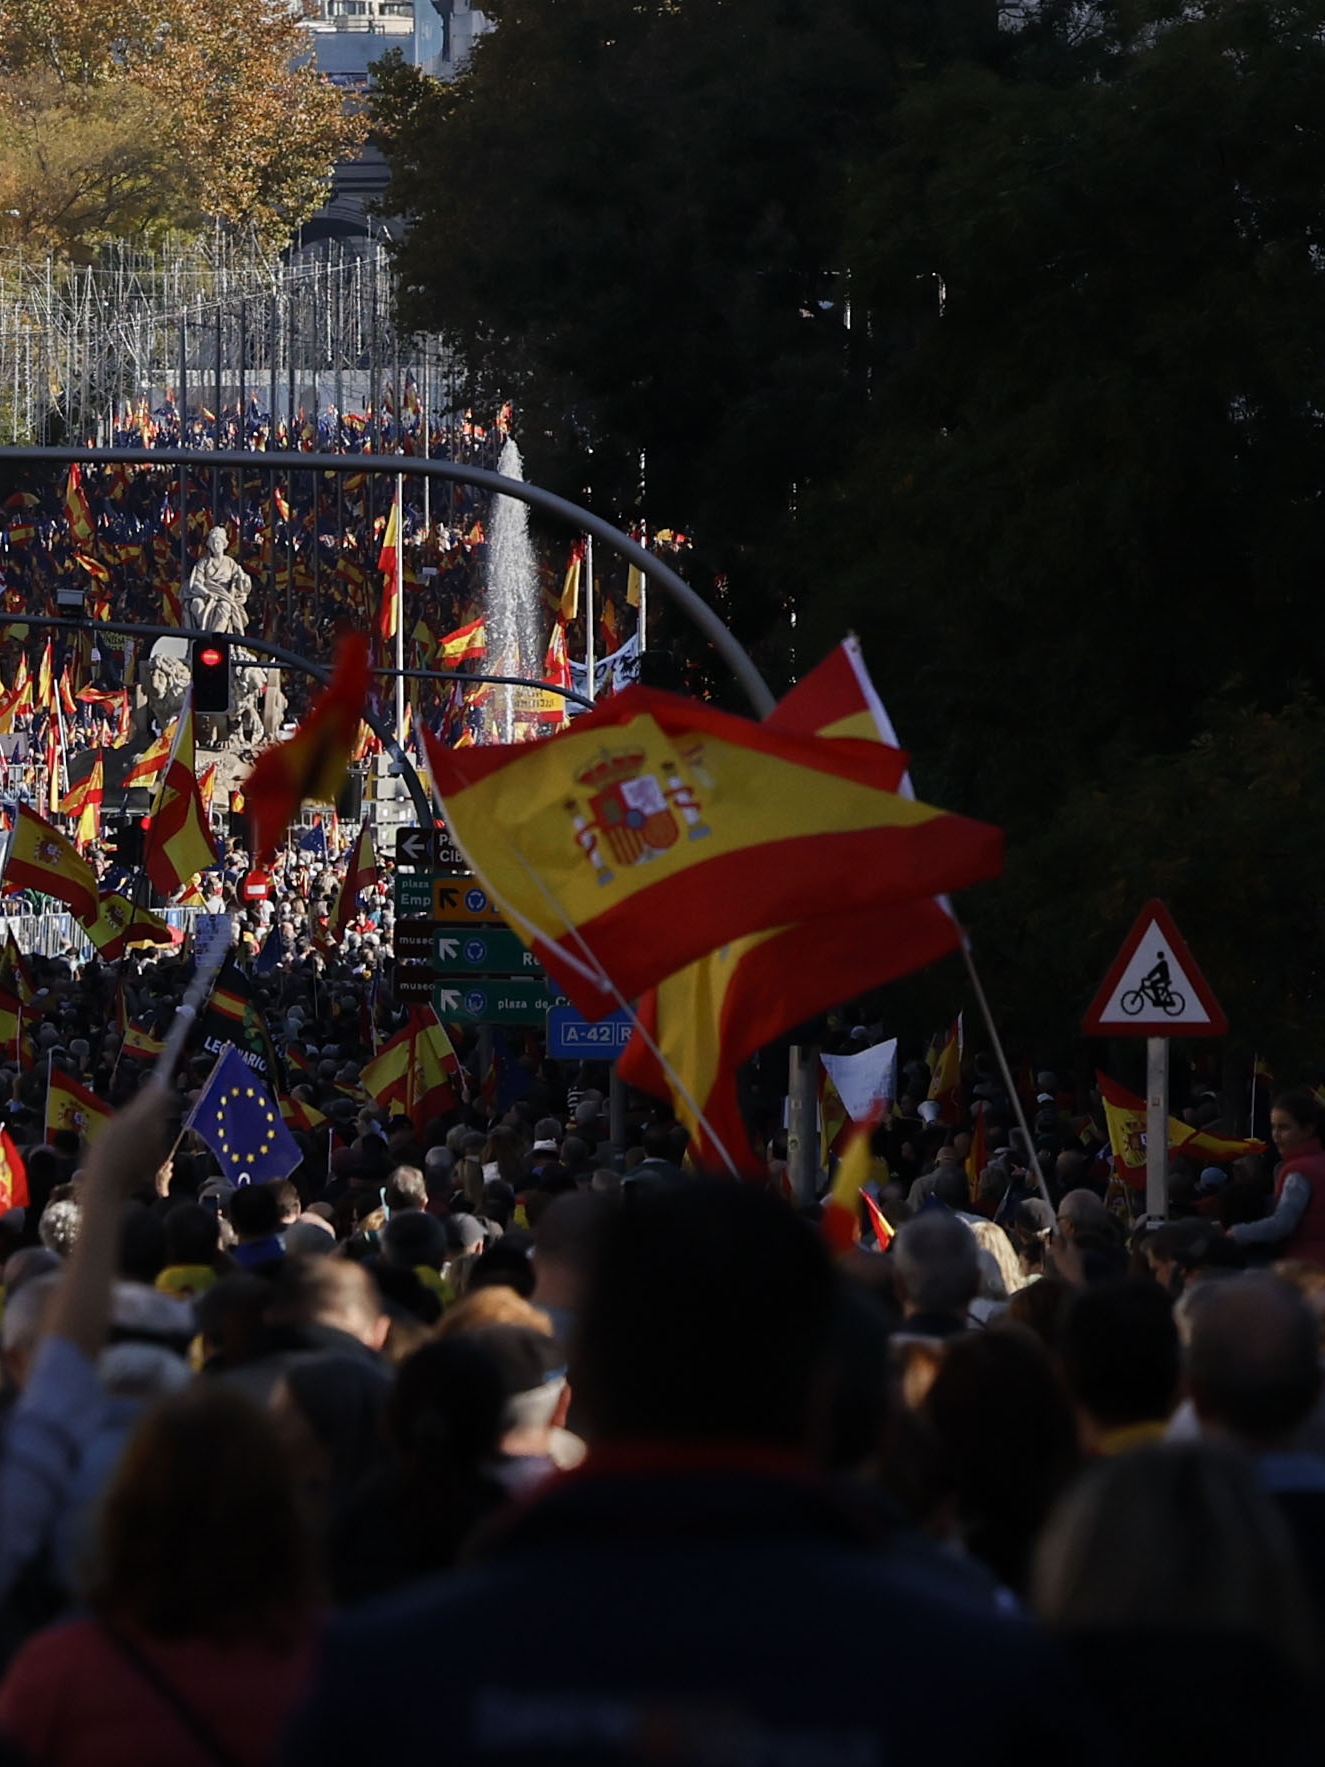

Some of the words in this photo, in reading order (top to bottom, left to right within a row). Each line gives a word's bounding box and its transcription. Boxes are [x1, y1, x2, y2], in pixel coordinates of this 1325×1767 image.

[497, 998, 528, 1010] plaza
[535, 998, 548, 1009] de
[566, 1026, 611, 1042] A-42
